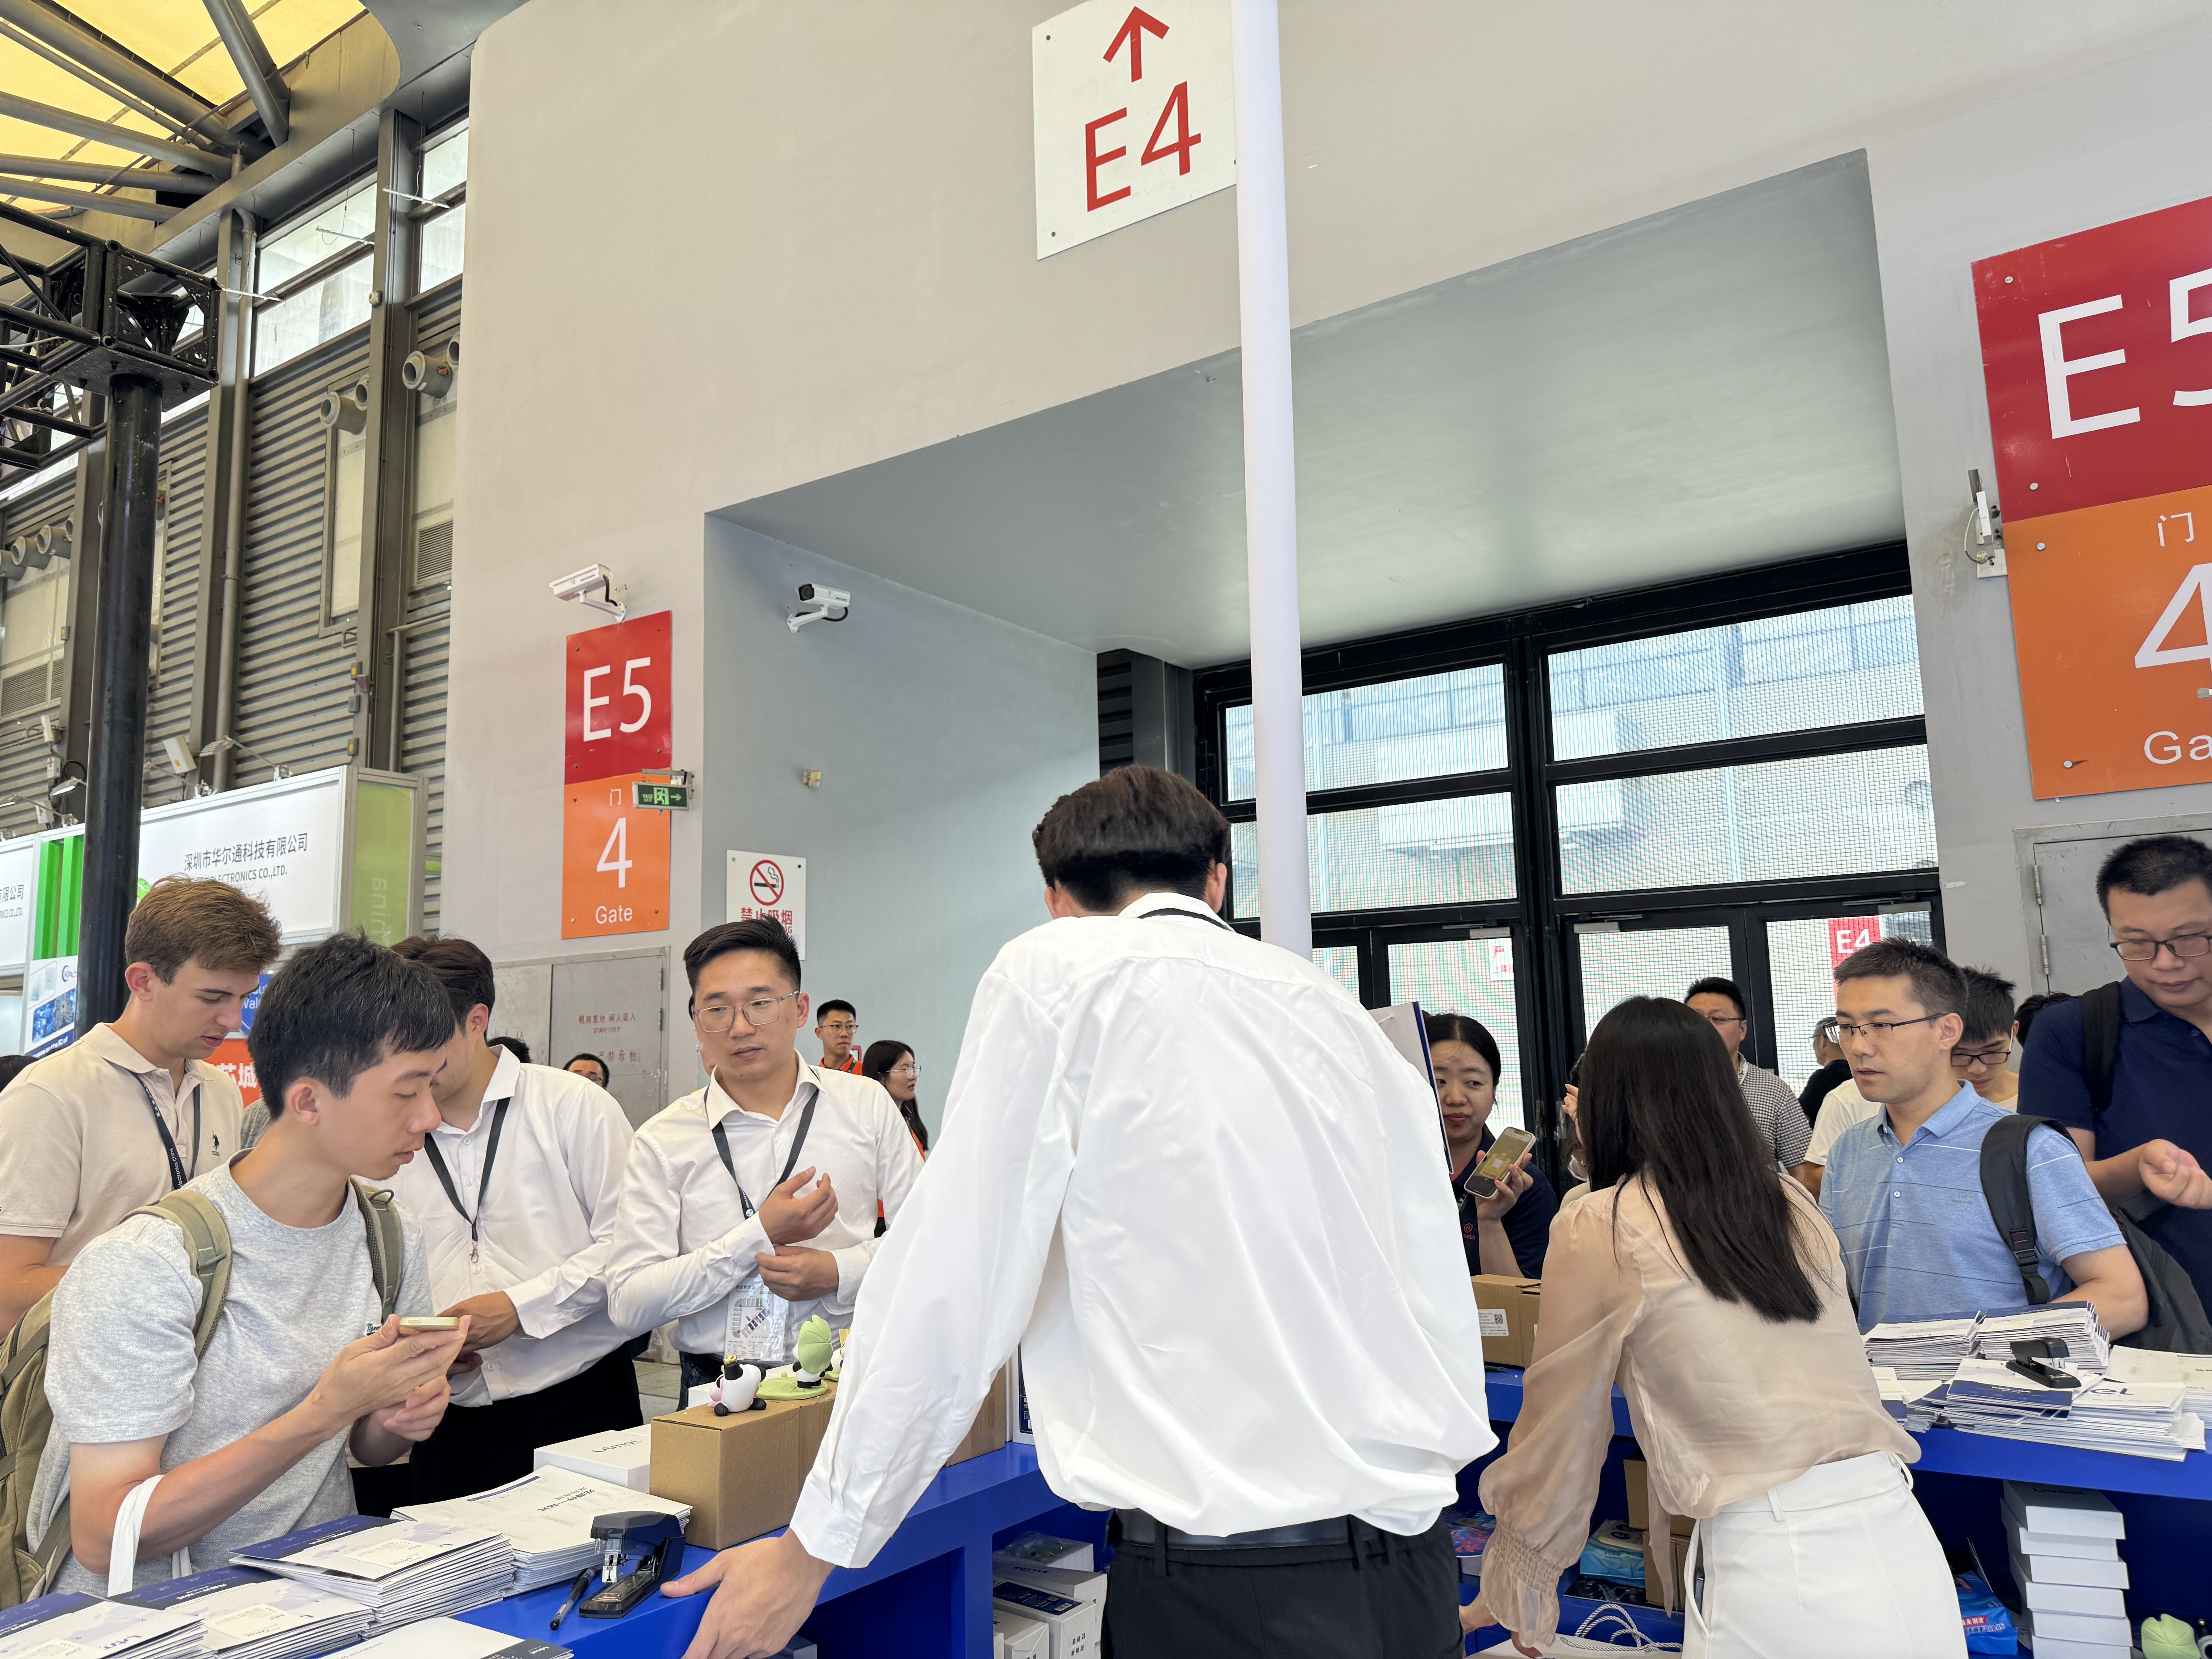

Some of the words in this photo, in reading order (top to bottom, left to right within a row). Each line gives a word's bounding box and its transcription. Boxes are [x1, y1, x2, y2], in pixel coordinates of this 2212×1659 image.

[1085, 81, 1201, 212] E4
[2157, 512, 2194, 546] 门
[2135, 562, 2212, 674] 4
[584, 657, 651, 742] E5
[2144, 731, 2212, 764] Ga
[610, 788, 621, 806] 门
[184, 833, 307, 871] 深圳市华尔通科技有限公司
[597, 817, 632, 888] 4
[596, 905, 632, 924] Gate
[1836, 929, 1872, 953] E4
